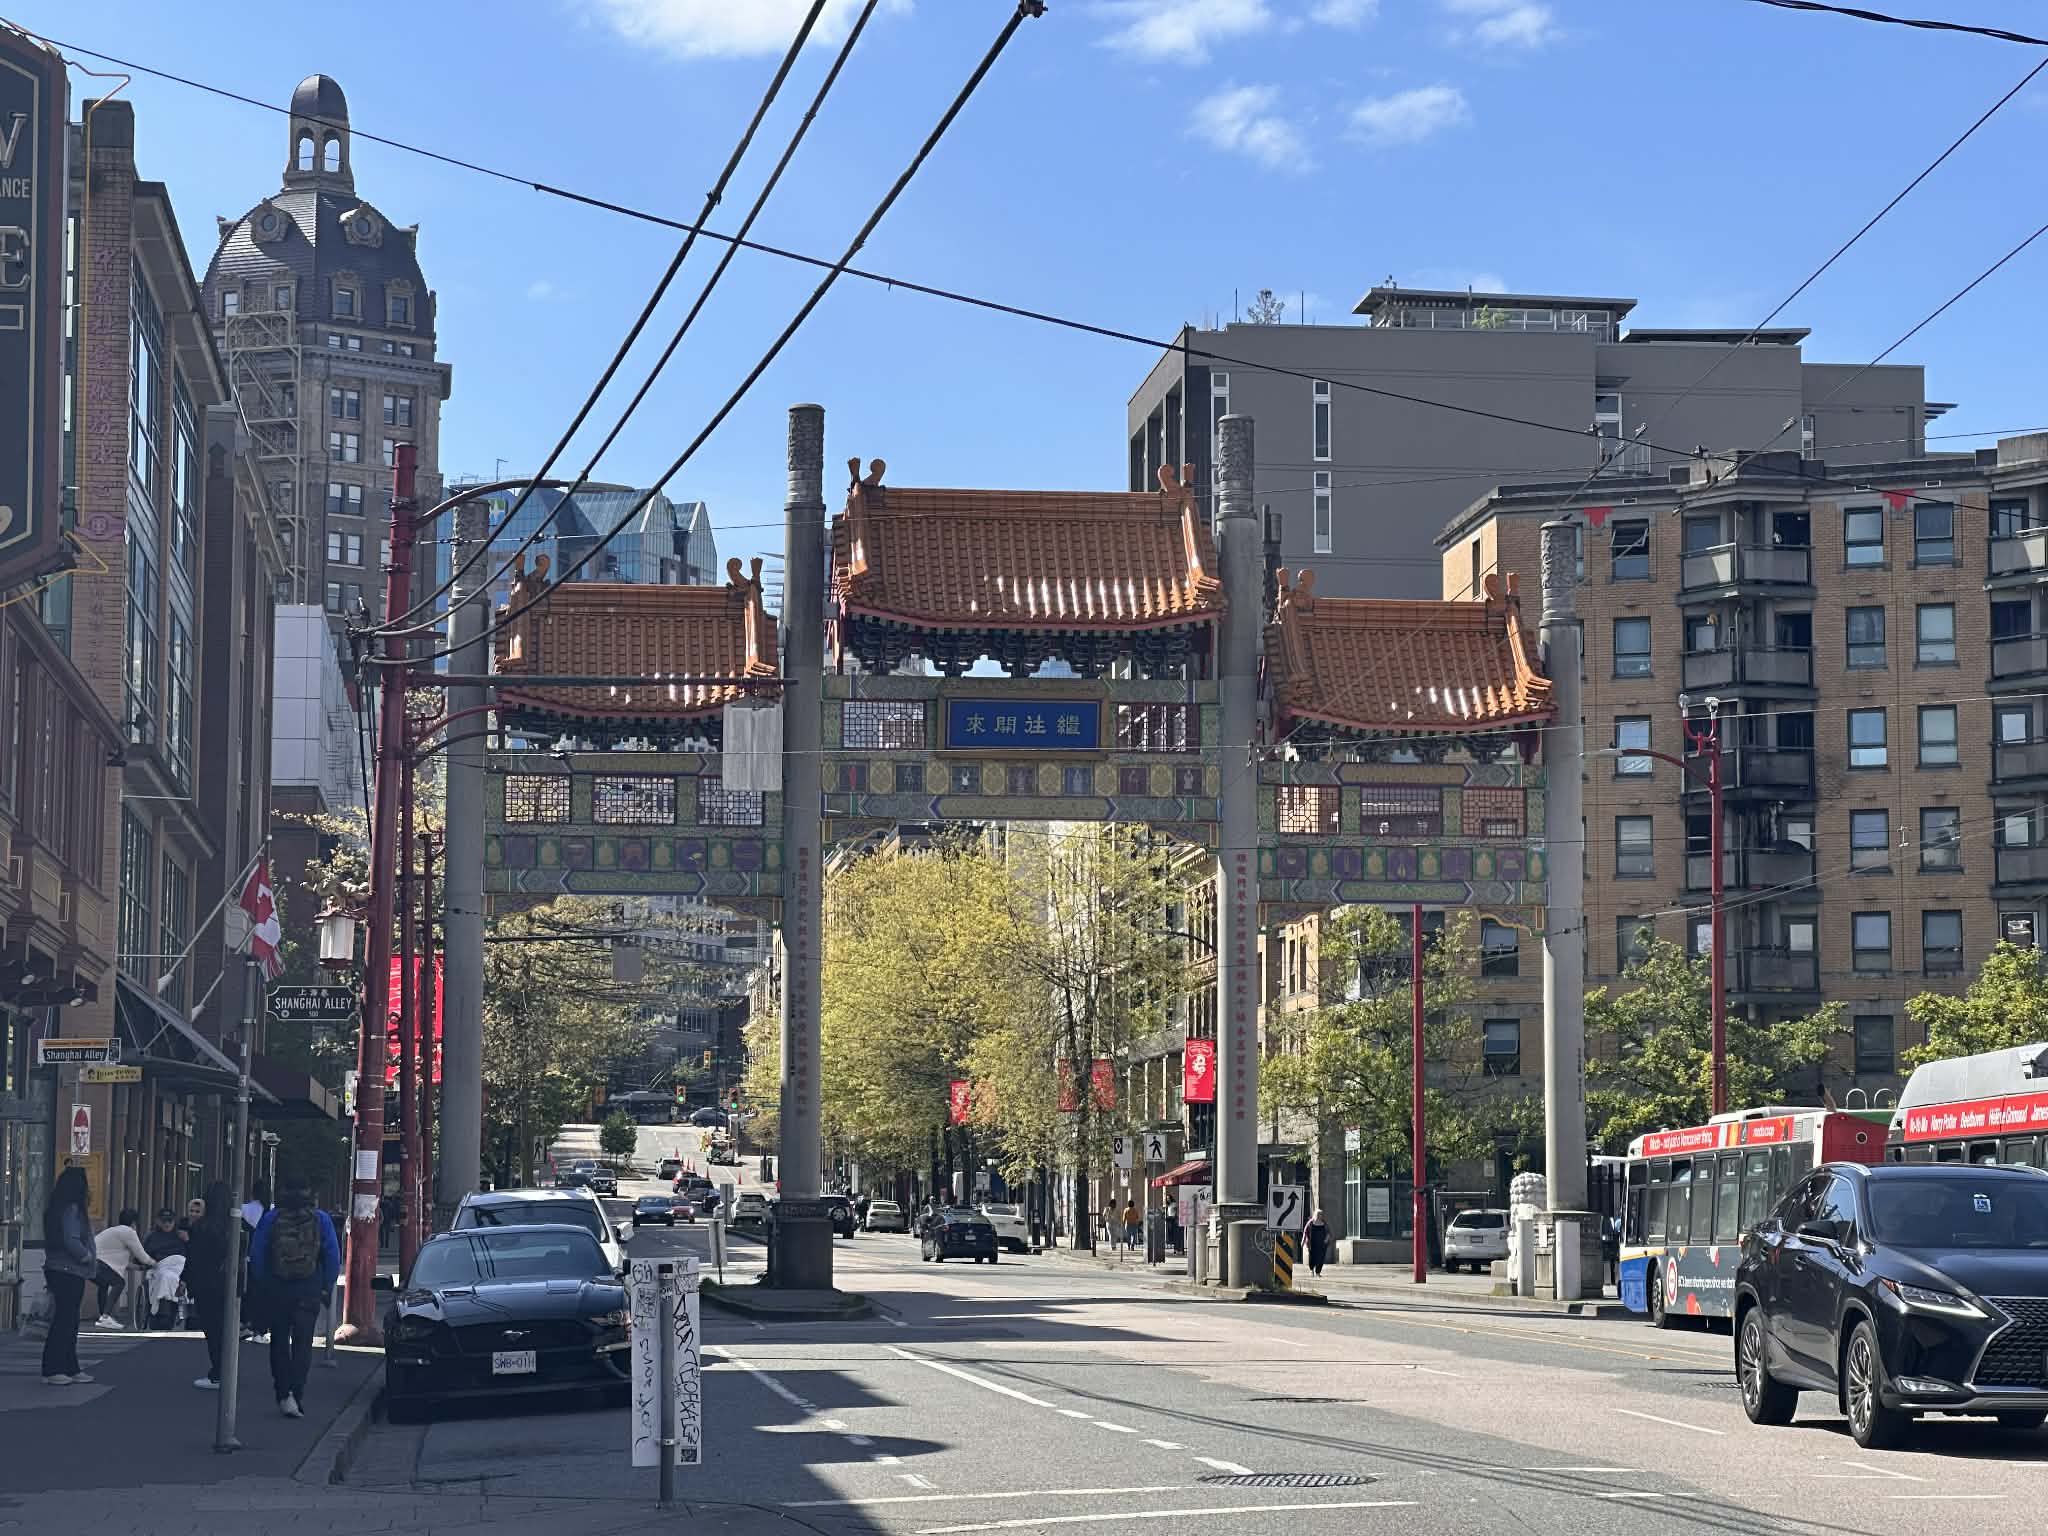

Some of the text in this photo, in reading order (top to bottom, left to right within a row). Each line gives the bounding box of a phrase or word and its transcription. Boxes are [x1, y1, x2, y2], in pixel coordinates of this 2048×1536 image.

[275, 997, 352, 1009] SHANGHAI ALLEY
[46, 1049, 105, 1061] Shanghai Alley
